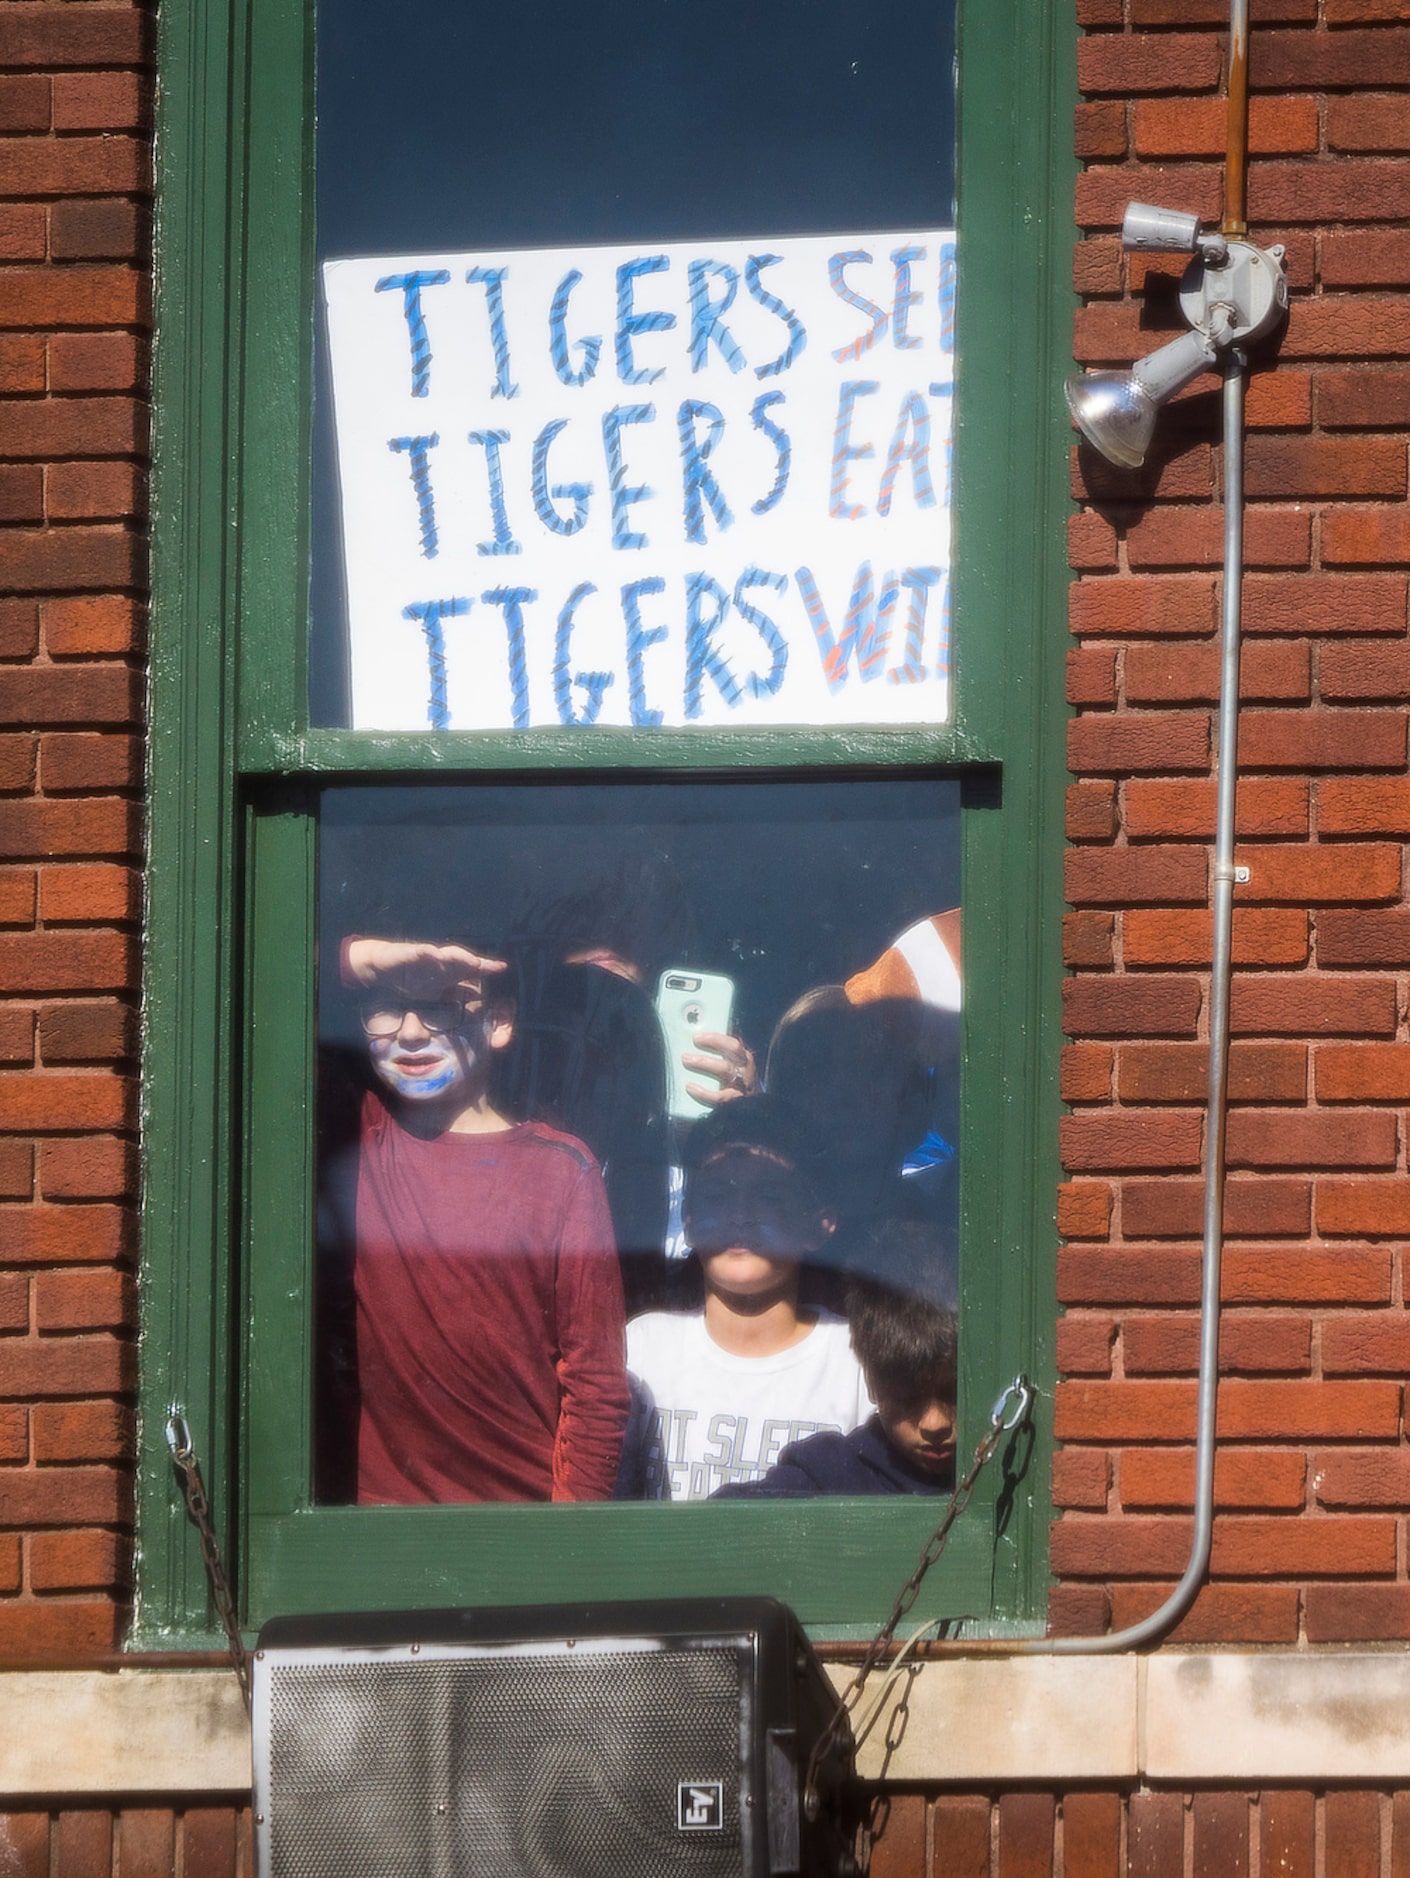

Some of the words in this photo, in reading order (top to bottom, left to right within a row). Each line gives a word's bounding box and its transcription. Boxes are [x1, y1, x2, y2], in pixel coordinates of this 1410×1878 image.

[375, 253, 807, 398] TIGERS
[387, 390, 792, 559] TIGERS
[402, 563, 788, 729] TIGERS
[794, 559, 950, 697] WI
[704, 1414, 842, 1470] SLE
